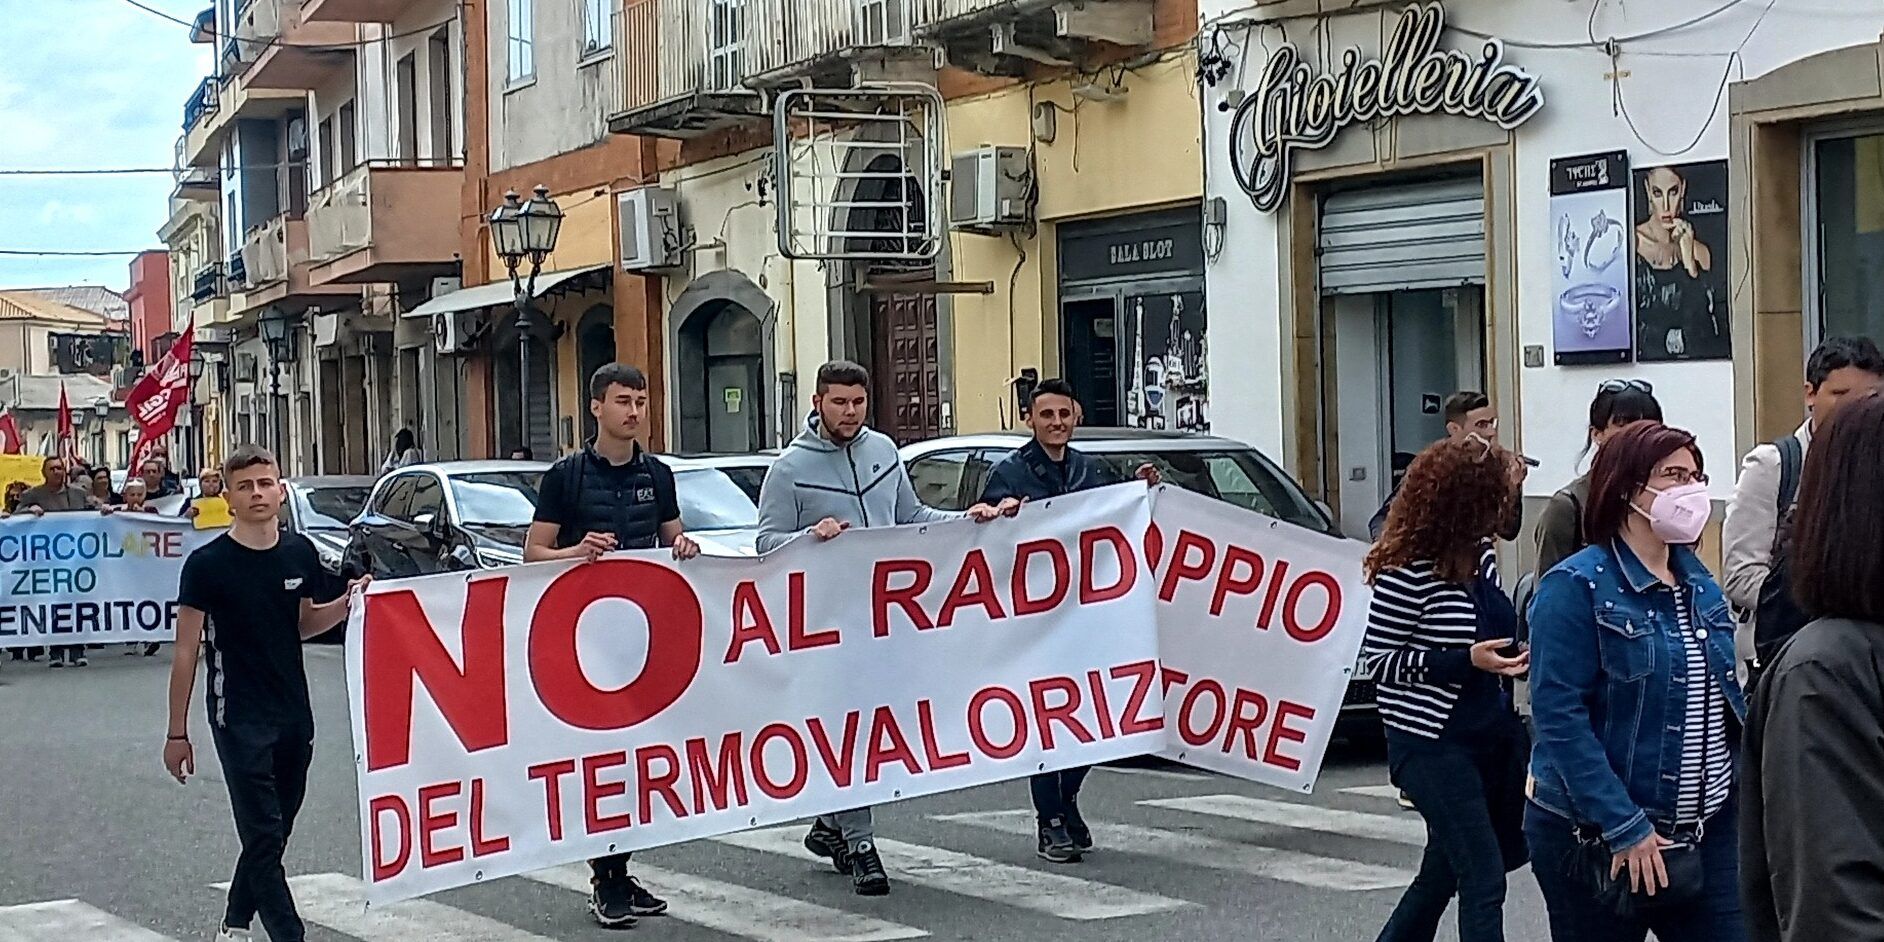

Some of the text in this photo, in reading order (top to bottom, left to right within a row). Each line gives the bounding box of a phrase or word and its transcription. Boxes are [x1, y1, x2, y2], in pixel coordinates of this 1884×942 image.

[1230, 1, 1543, 211] Gioielleria
[1110, 239, 1173, 264] SALA SLOT
[11, 566, 96, 595] ZERO
[364, 557, 704, 772] NO
[723, 571, 842, 664] AL
[370, 776, 511, 883] DEL
